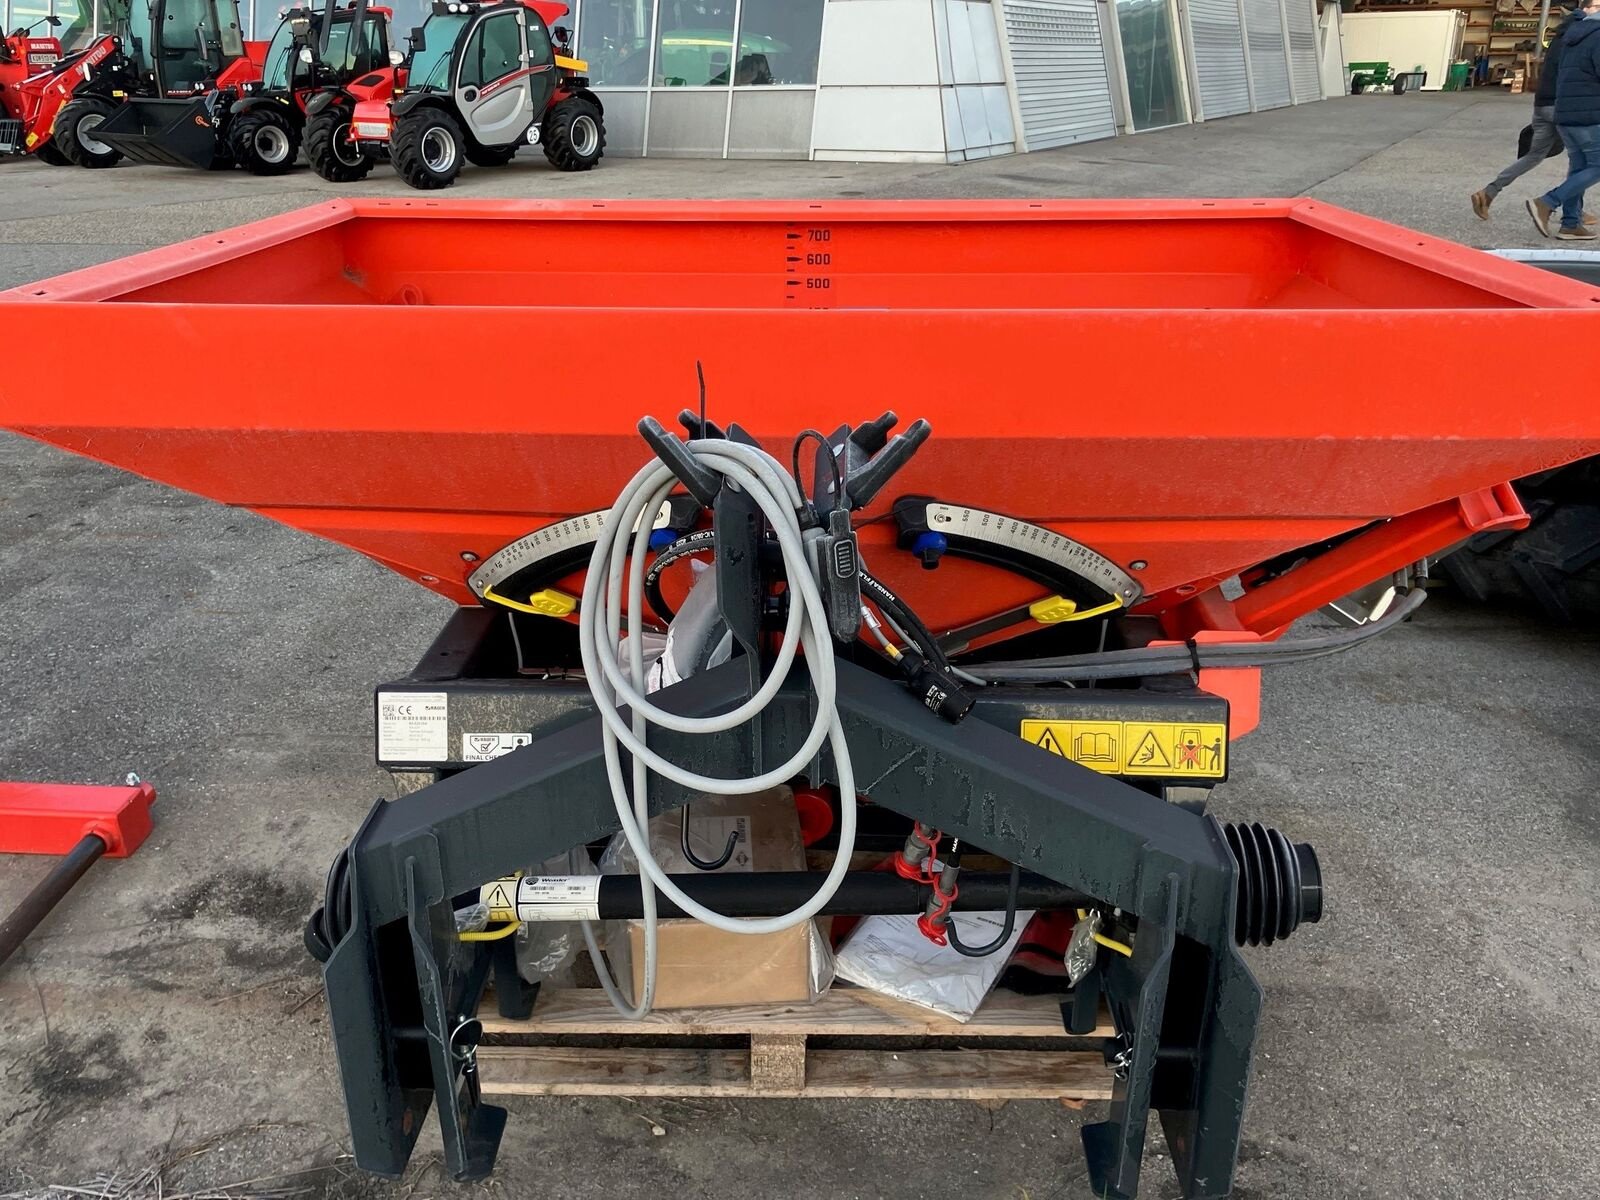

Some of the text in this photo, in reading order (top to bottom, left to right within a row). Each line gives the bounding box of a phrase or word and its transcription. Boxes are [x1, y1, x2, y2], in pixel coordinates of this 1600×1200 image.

[75, 46, 106, 76] MNITOU
[529, 130, 538, 142] 25
[808, 230, 830, 242] 700
[807, 254, 830, 265] 600
[806, 278, 830, 288] 500
[962, 510, 970, 522] 550
[543, 530, 551, 542] 200
[1021, 525, 1029, 536] 350
[1031, 528, 1039, 540] 300
[1041, 532, 1049, 544] 250
[1051, 537, 1060, 548] 200
[860, 570, 895, 602] HANSA/FLE
